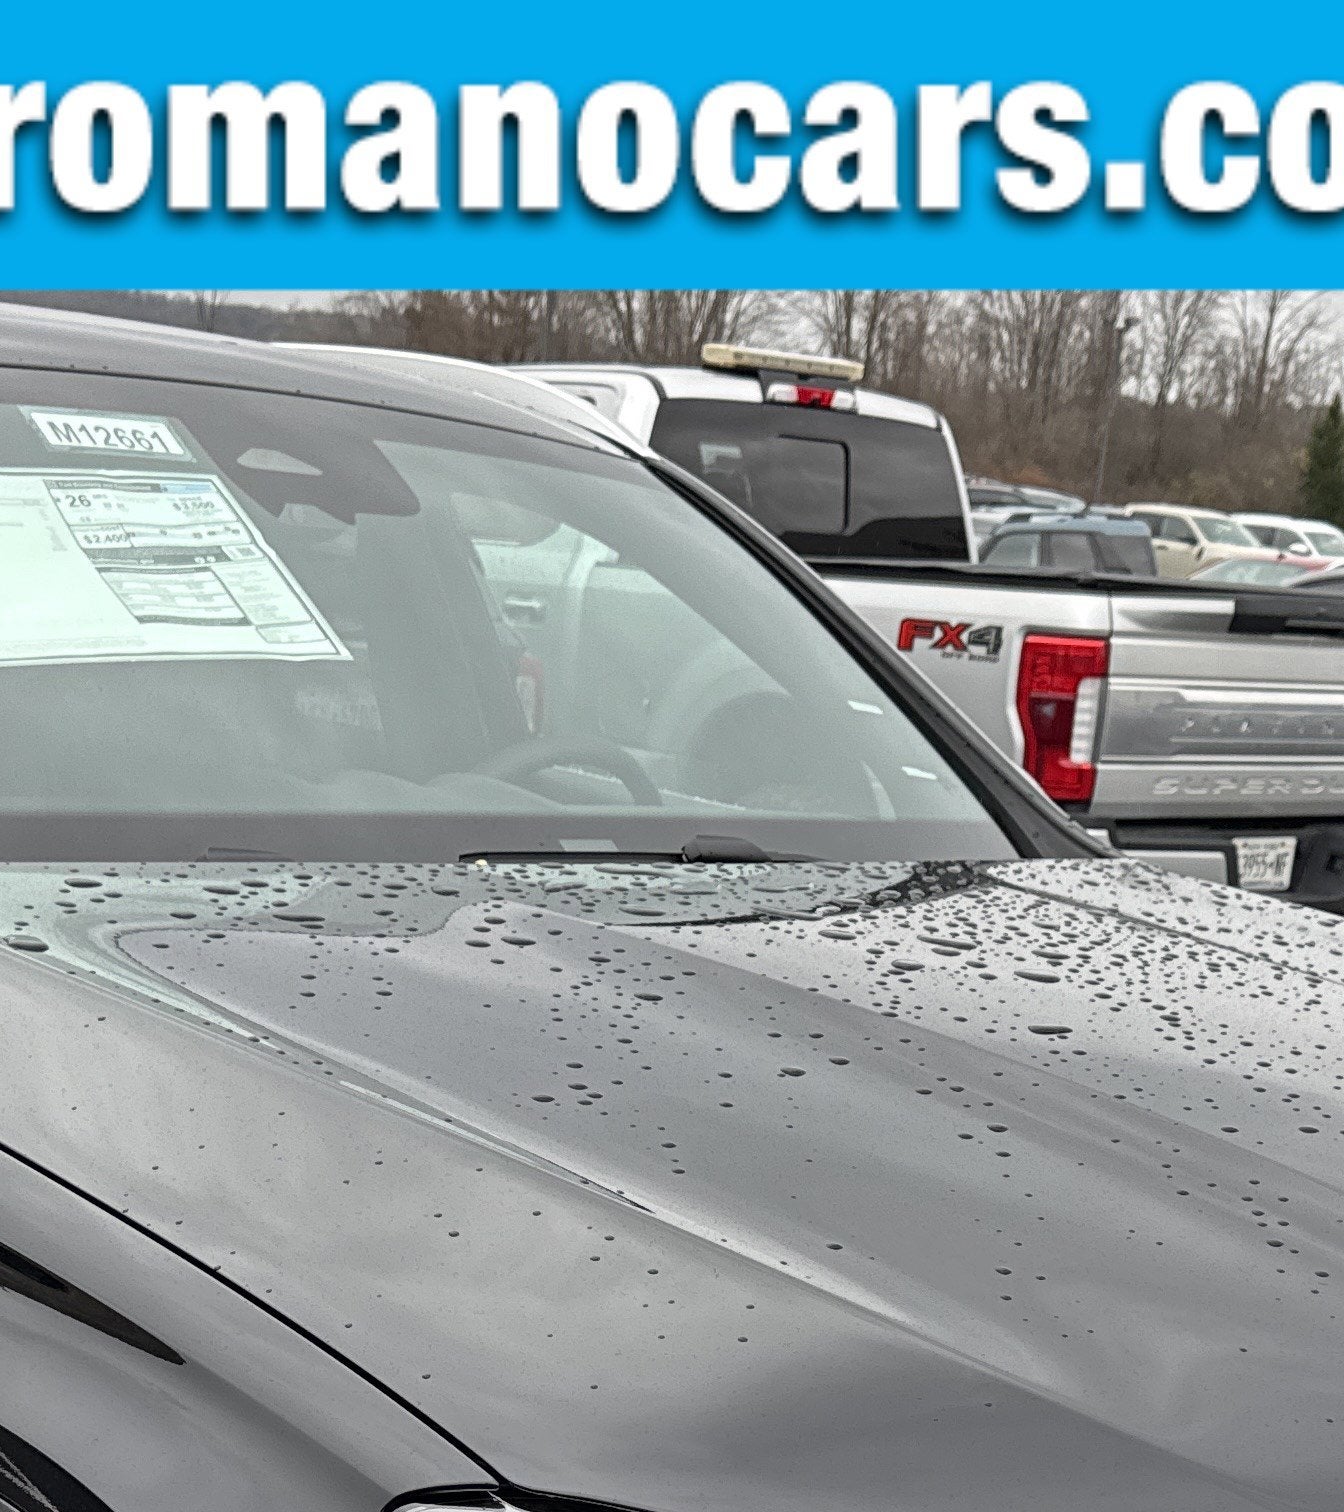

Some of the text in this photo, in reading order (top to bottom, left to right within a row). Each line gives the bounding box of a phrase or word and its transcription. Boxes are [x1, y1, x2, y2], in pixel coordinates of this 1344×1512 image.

[47, 421, 170, 453] M12661
[65, 494, 91, 507] 26
[897, 618, 1004, 655] FX4
[1153, 776, 1292, 795] SUPER
